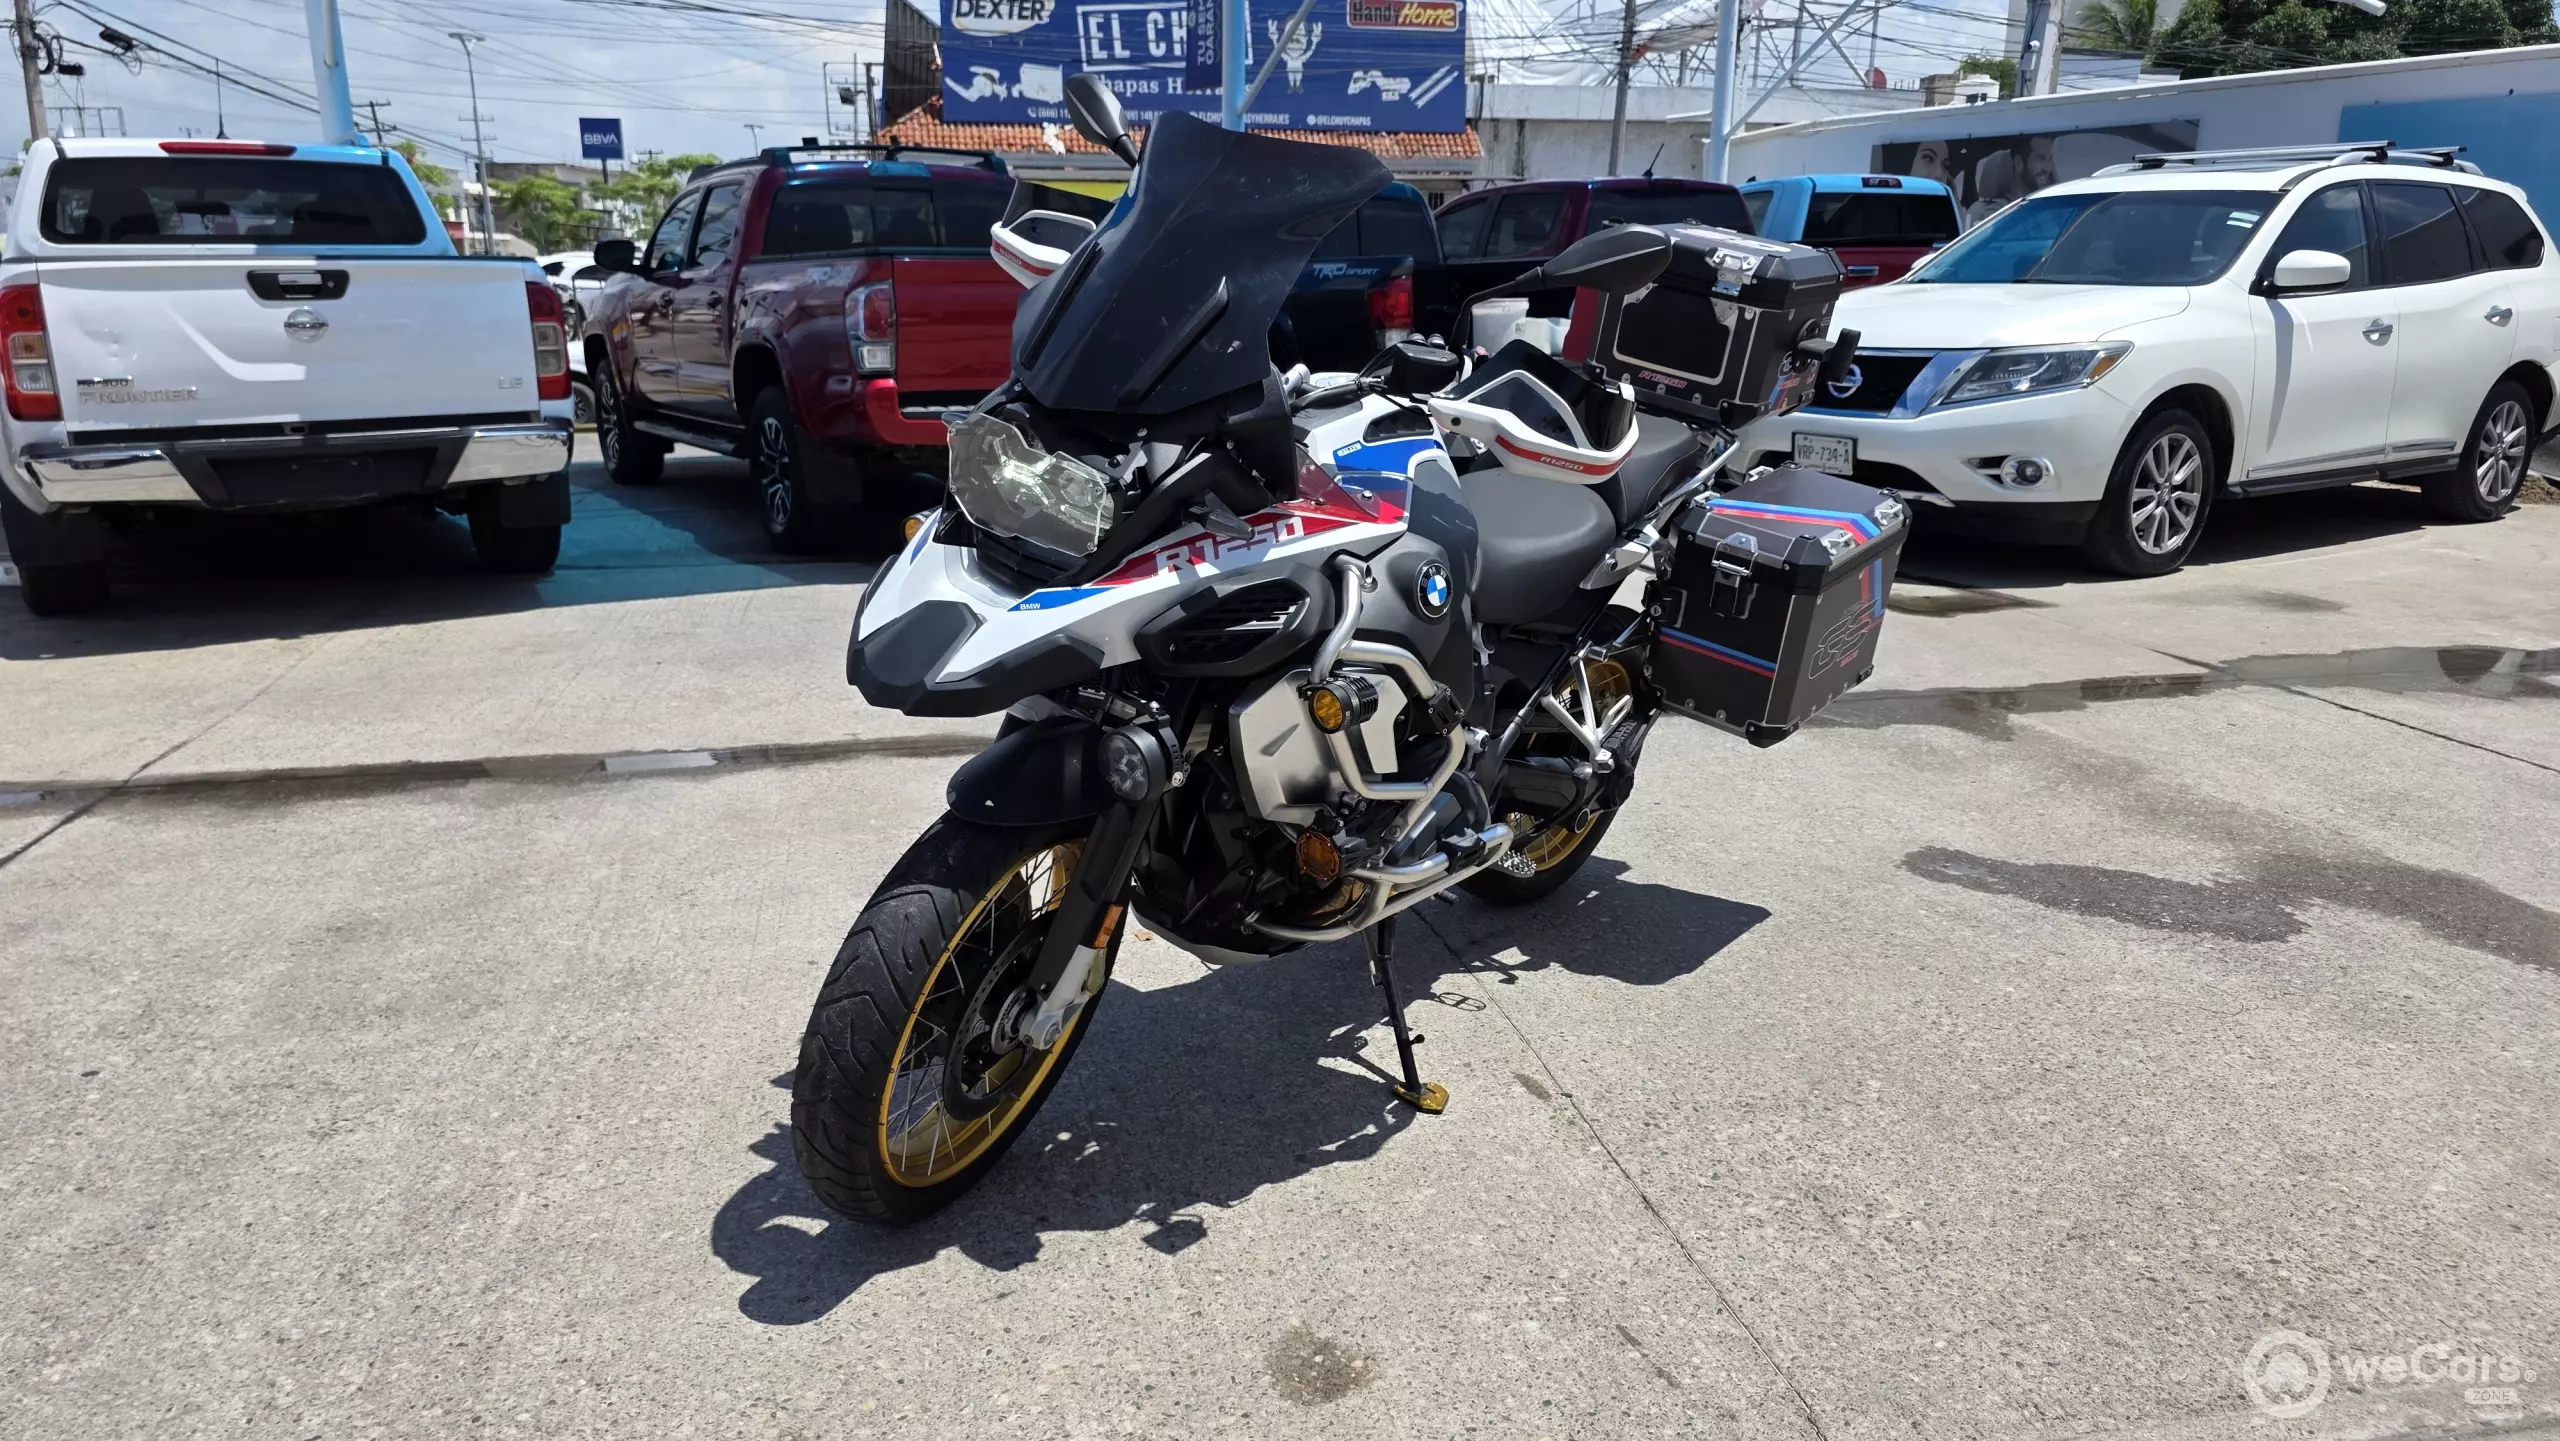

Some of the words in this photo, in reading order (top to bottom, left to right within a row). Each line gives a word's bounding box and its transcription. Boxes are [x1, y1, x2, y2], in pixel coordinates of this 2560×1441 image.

[956, 0, 1045, 20] DEXTER
[1399, 2, 1455, 26] Home
[1088, 13, 1131, 60] EL
[1099, 73, 1160, 97] hapas
[583, 132, 619, 145] BBVA
[1313, 263, 1347, 280] TRD
[79, 386, 199, 405] FRONTIER
[1540, 455, 1584, 471] R1250
[1797, 443, 1850, 465] VRP-734-A
[1020, 602, 1041, 610] BMW
